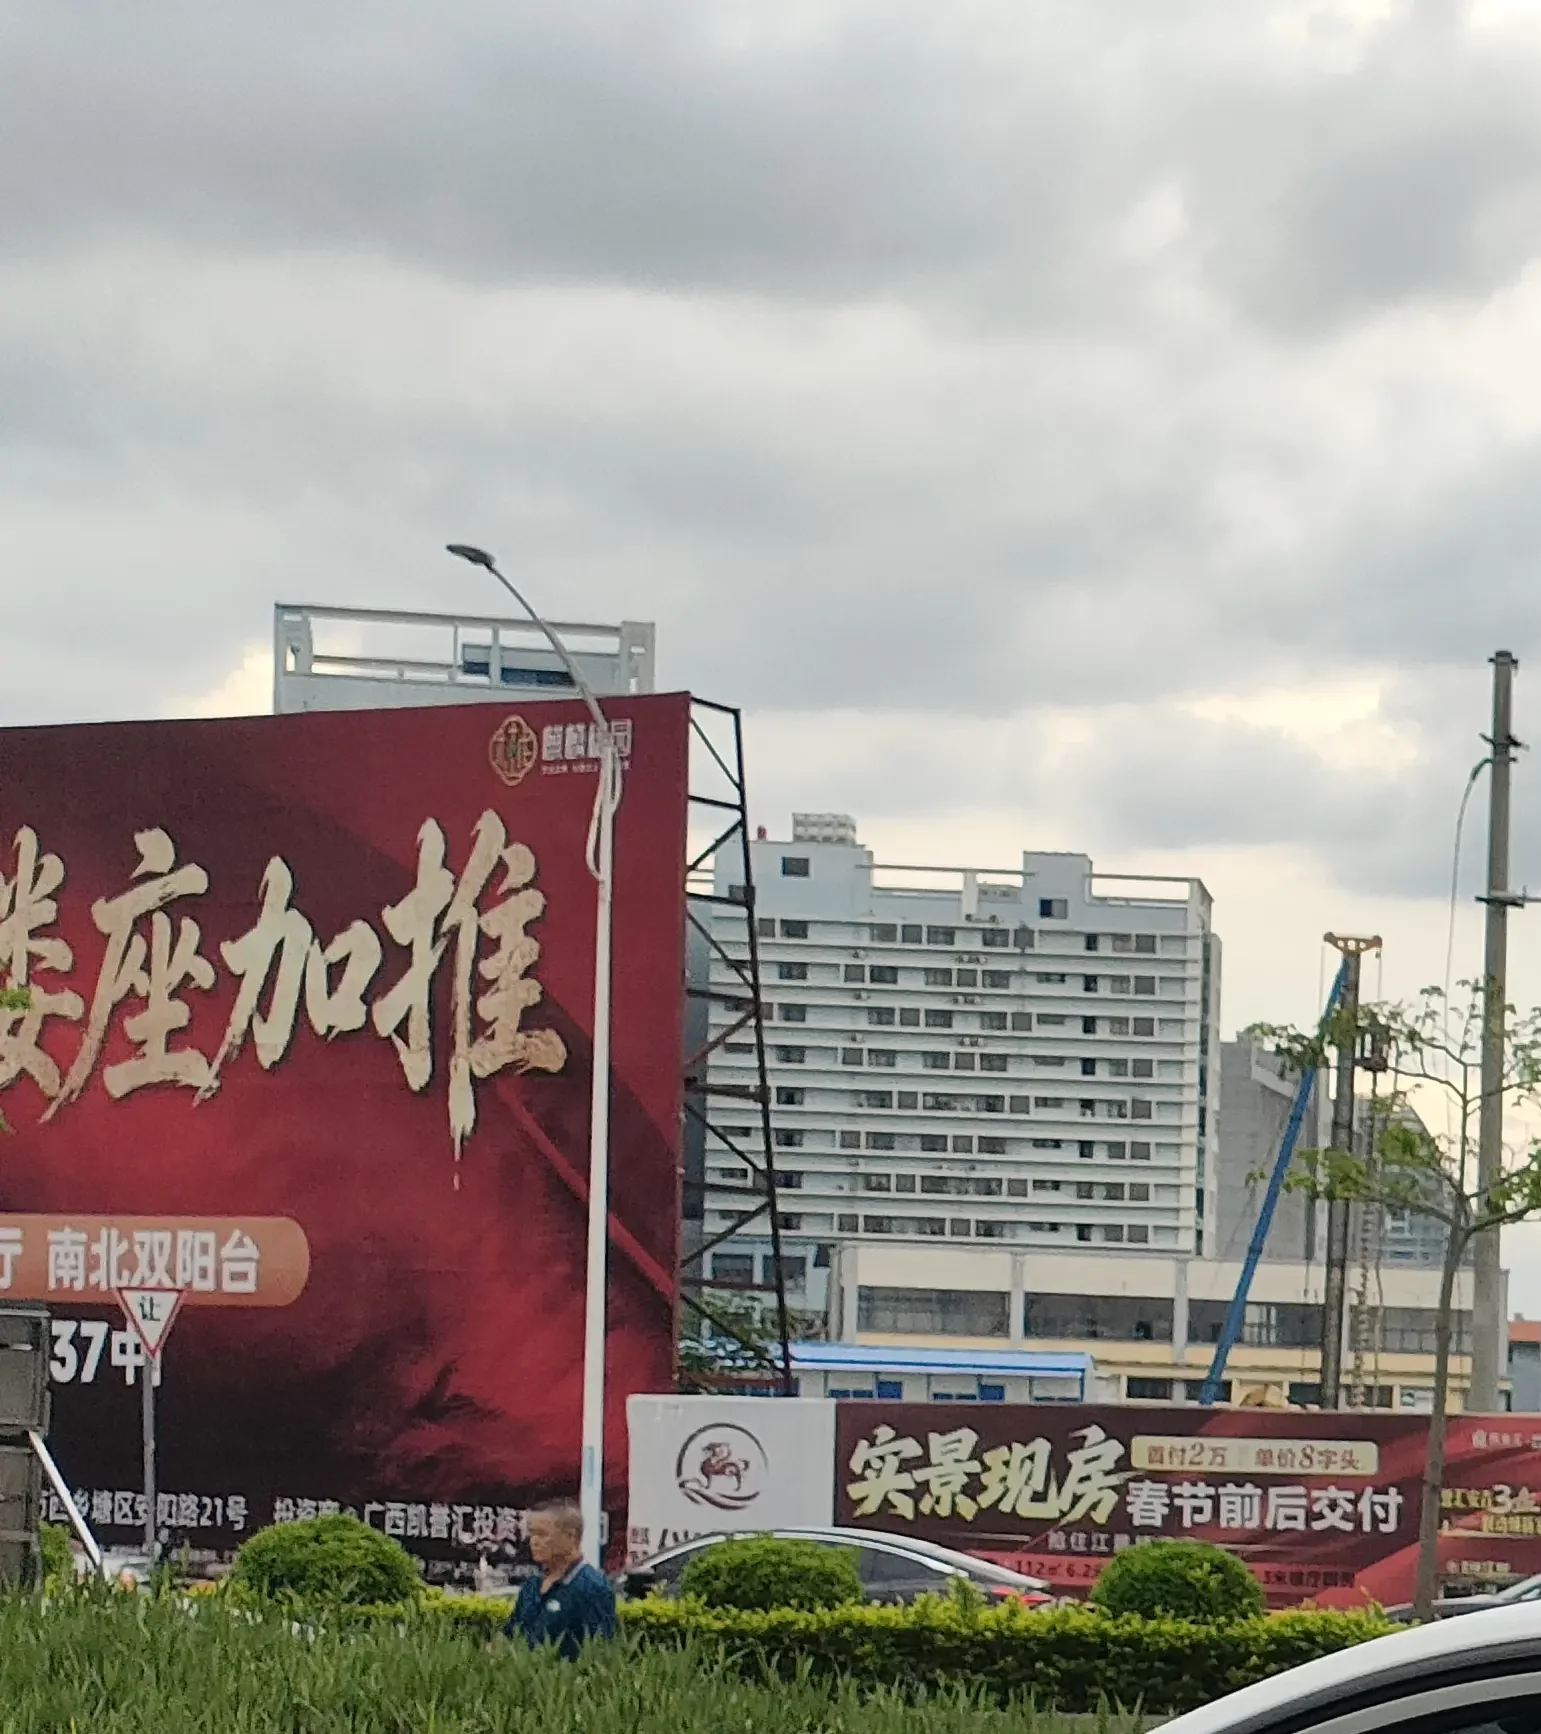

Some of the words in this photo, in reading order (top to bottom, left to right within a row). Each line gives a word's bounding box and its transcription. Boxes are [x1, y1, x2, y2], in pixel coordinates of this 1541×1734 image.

[47, 1224, 261, 1293] 南北双阳台
[138, 1295, 161, 1322] 让
[50, 1319, 162, 1388] 37中
[845, 1423, 1134, 1526] 实景现房
[1125, 1478, 1403, 1534] 春节前后交付
